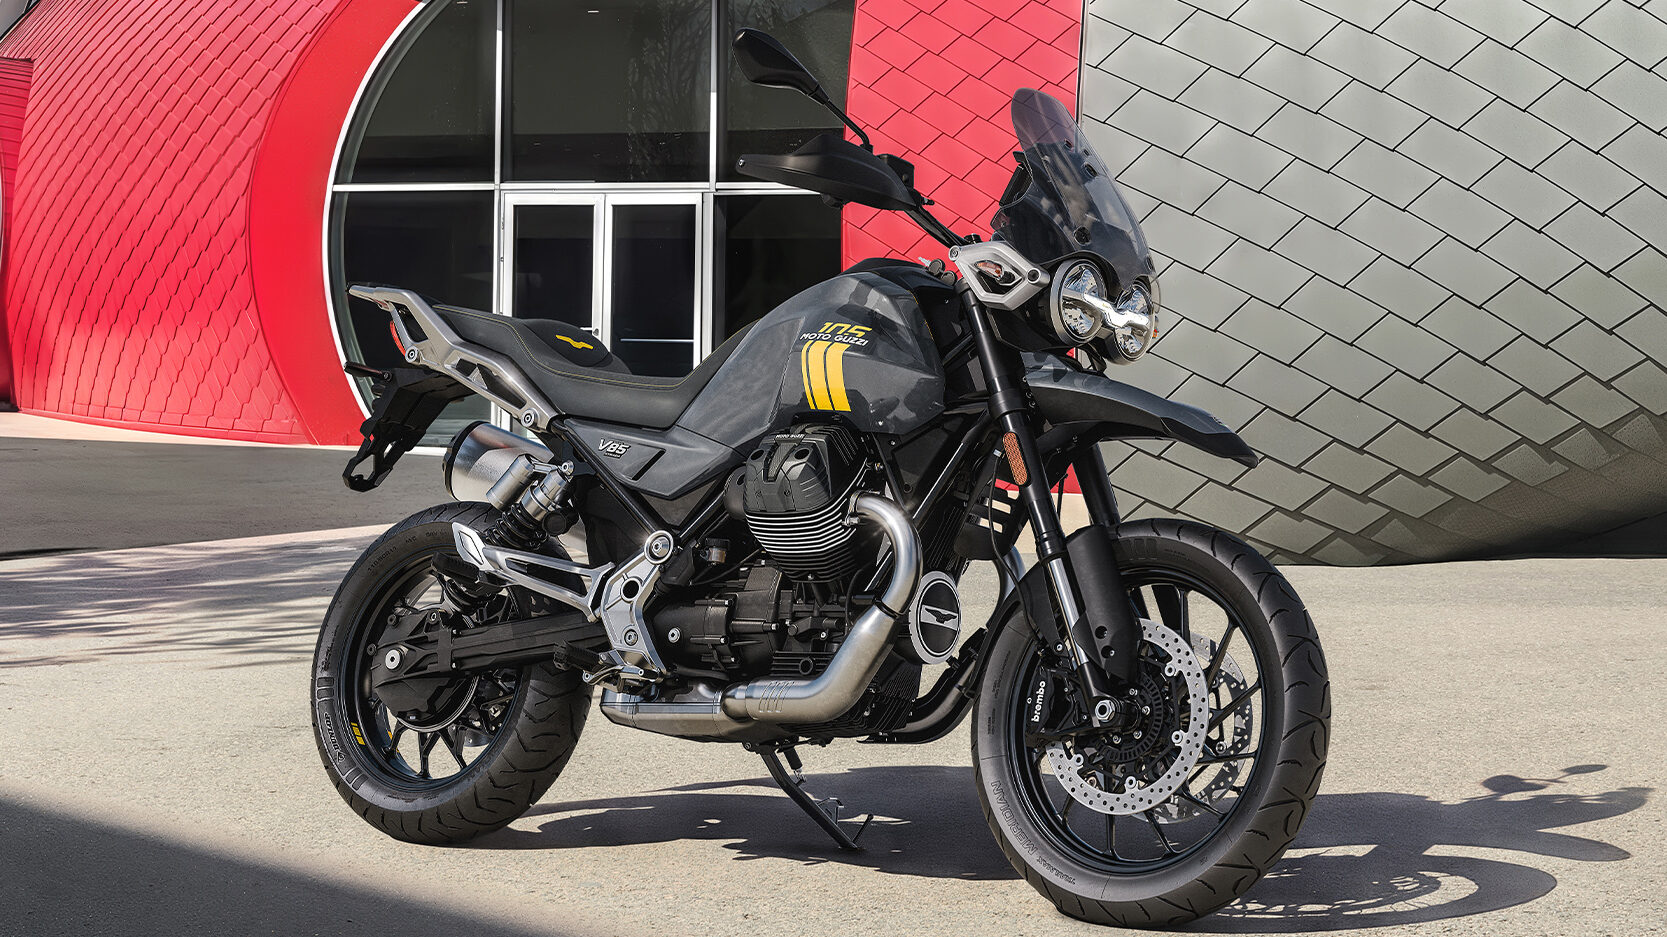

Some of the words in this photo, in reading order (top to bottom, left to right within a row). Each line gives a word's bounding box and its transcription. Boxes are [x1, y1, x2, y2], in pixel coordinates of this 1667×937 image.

[799, 332, 832, 341] MOTO
[834, 335, 869, 347] GUZZI
[598, 438, 631, 455] V85
[1031, 681, 1046, 722] brembo
[323, 711, 341, 752] DUNLOP
[991, 780, 1038, 856] MERIDIAN
